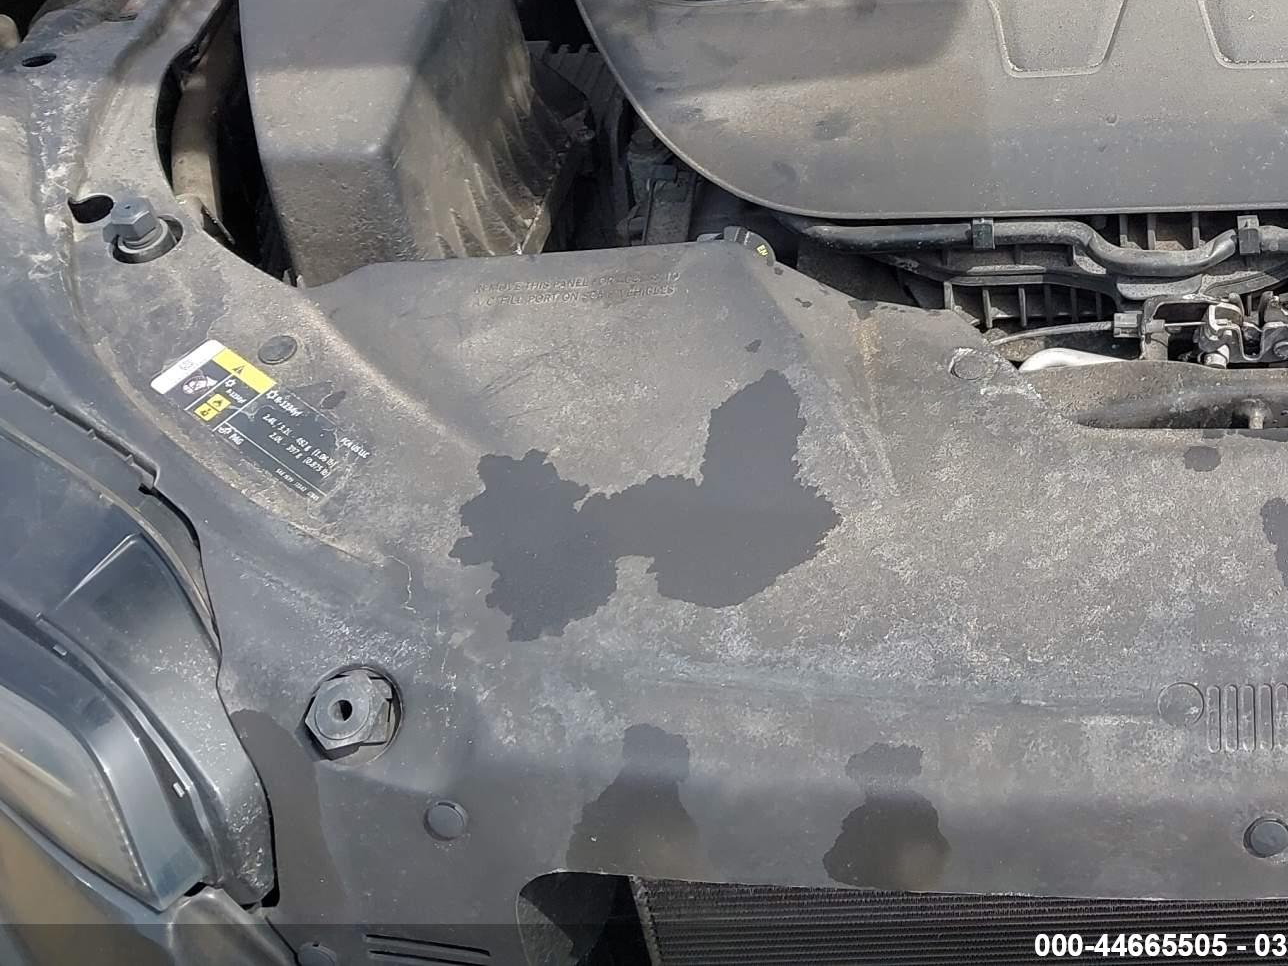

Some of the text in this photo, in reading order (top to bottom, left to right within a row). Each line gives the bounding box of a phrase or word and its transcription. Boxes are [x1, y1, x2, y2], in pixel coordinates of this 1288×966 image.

[526, 280, 551, 291] THIS
[552, 276, 590, 290] PANEL
[500, 293, 524, 305] FILL
[528, 291, 560, 304] PORT
[562, 291, 579, 303] ON
